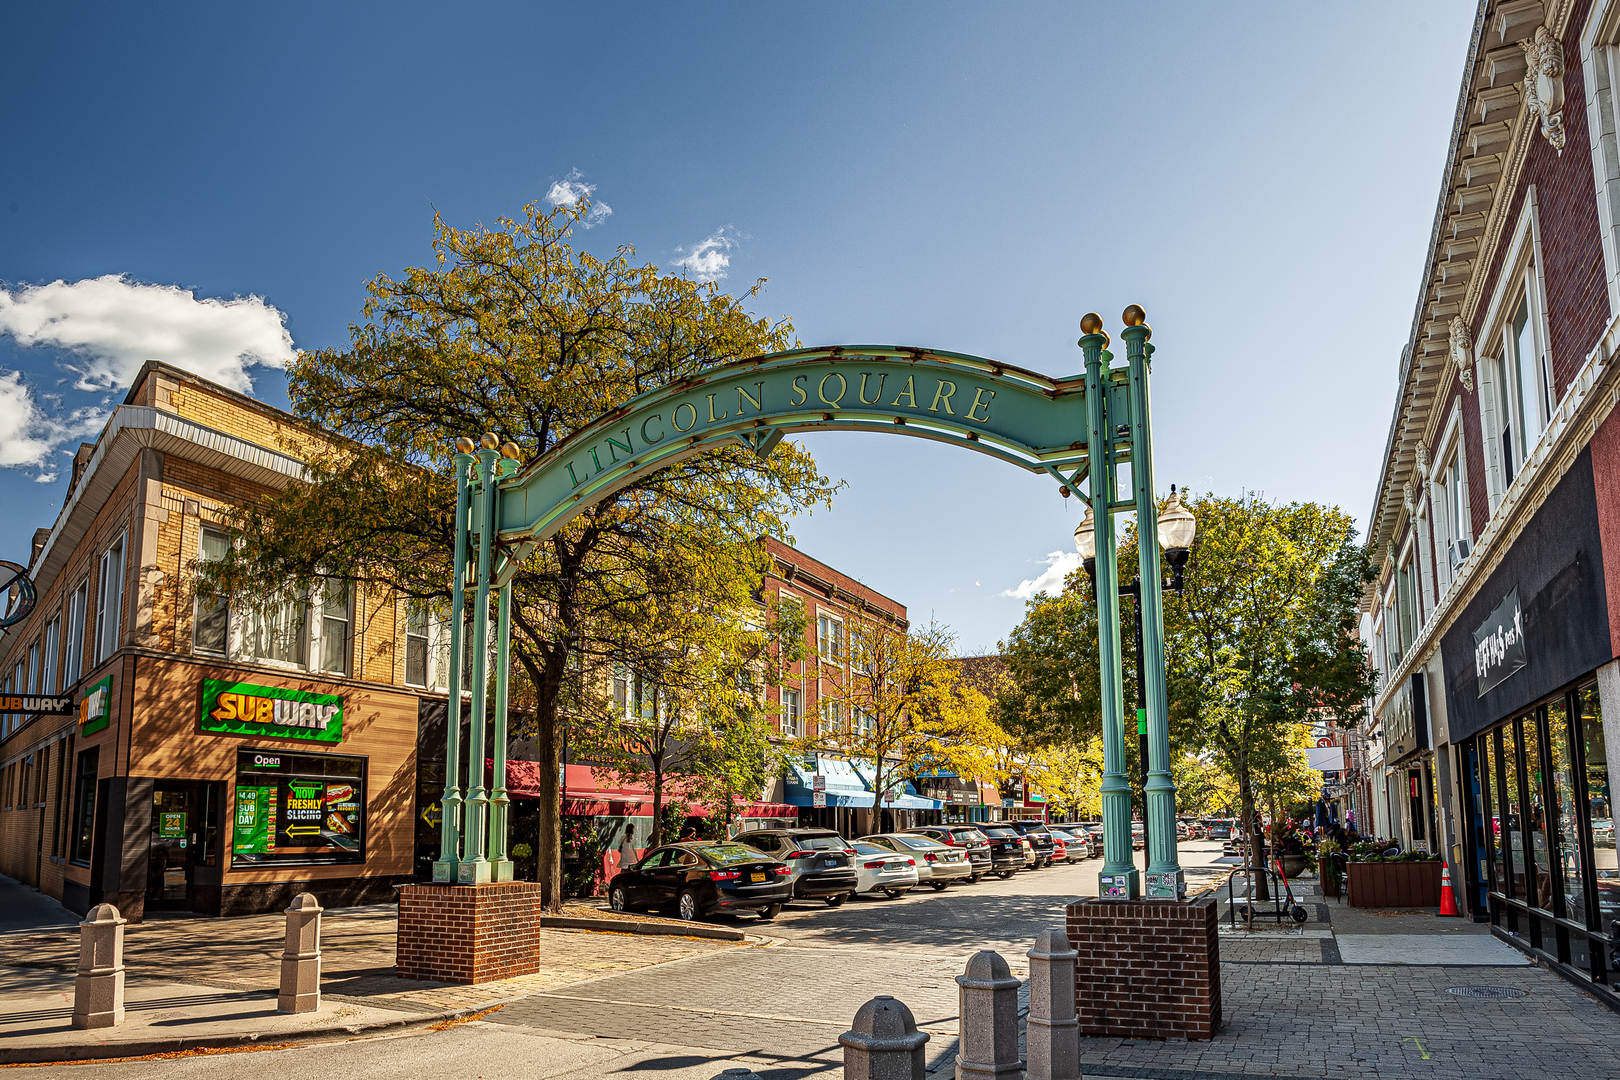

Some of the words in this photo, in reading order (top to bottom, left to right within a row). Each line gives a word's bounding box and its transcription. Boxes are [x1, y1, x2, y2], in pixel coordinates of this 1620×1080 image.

[564, 381, 765, 490] LINCOLN
[790, 372, 999, 424] SQUARE
[210, 692, 340, 731] SUBWAY
[254, 755, 280, 767] Open
[238, 791, 256, 800] $4.49
[295, 789, 316, 799] NOW
[287, 799, 323, 810] FRESHLY
[238, 815, 255, 825] DAY
[287, 809, 322, 820] SLICING
[165, 818, 180, 827] 24
